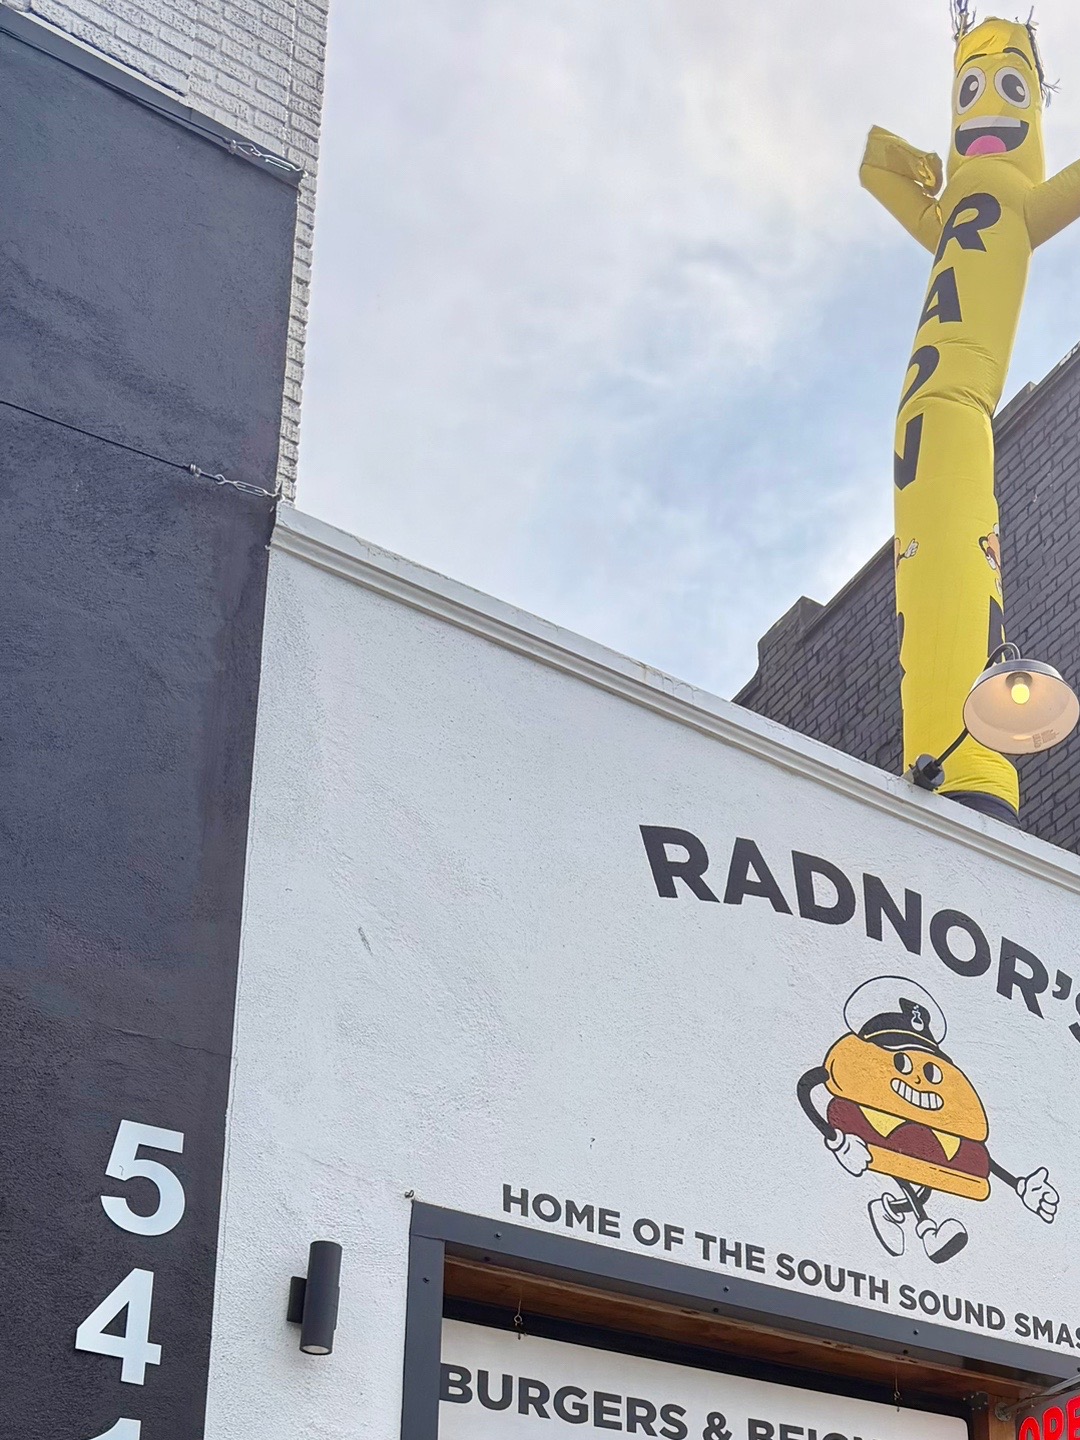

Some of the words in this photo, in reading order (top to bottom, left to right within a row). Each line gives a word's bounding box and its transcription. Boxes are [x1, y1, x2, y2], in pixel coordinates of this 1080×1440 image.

[503, 1184, 621, 1239] HOME
[632, 1218, 684, 1252] OF
[695, 1231, 765, 1274] THE
[775, 1252, 891, 1306] SOUTH
[899, 1284, 1006, 1331] SOUND
[440, 1363, 688, 1440] BURGERS
